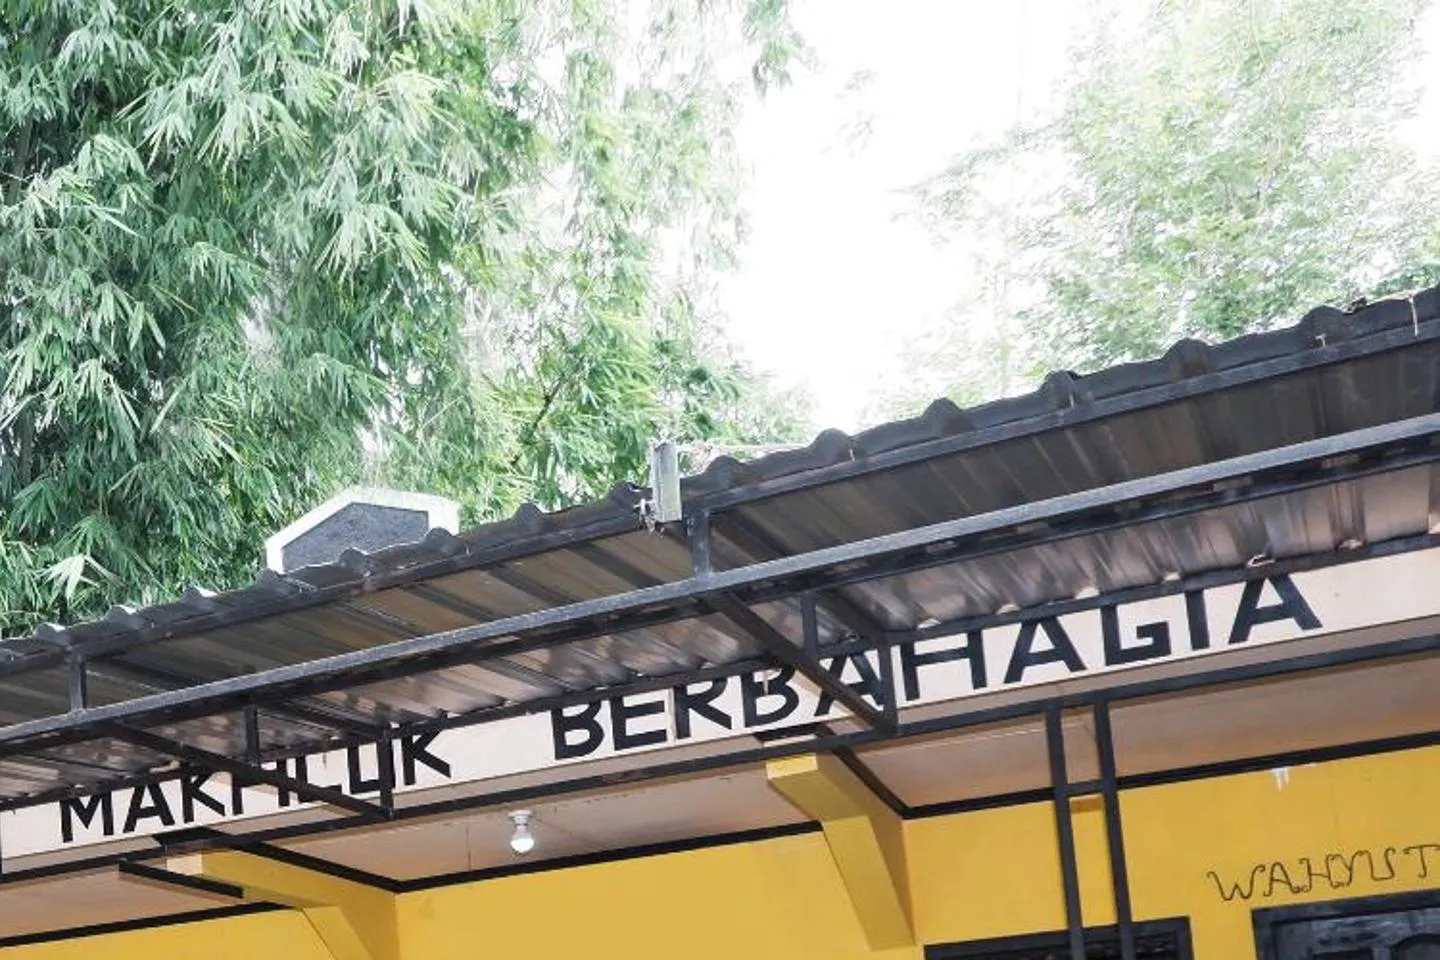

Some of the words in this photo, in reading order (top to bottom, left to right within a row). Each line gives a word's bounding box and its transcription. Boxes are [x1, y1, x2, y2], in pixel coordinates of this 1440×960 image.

[61, 729, 453, 843] MAKHLUK
[551, 572, 1323, 760] BERBAHAGIA
[1206, 848, 1397, 901] WAHYU
